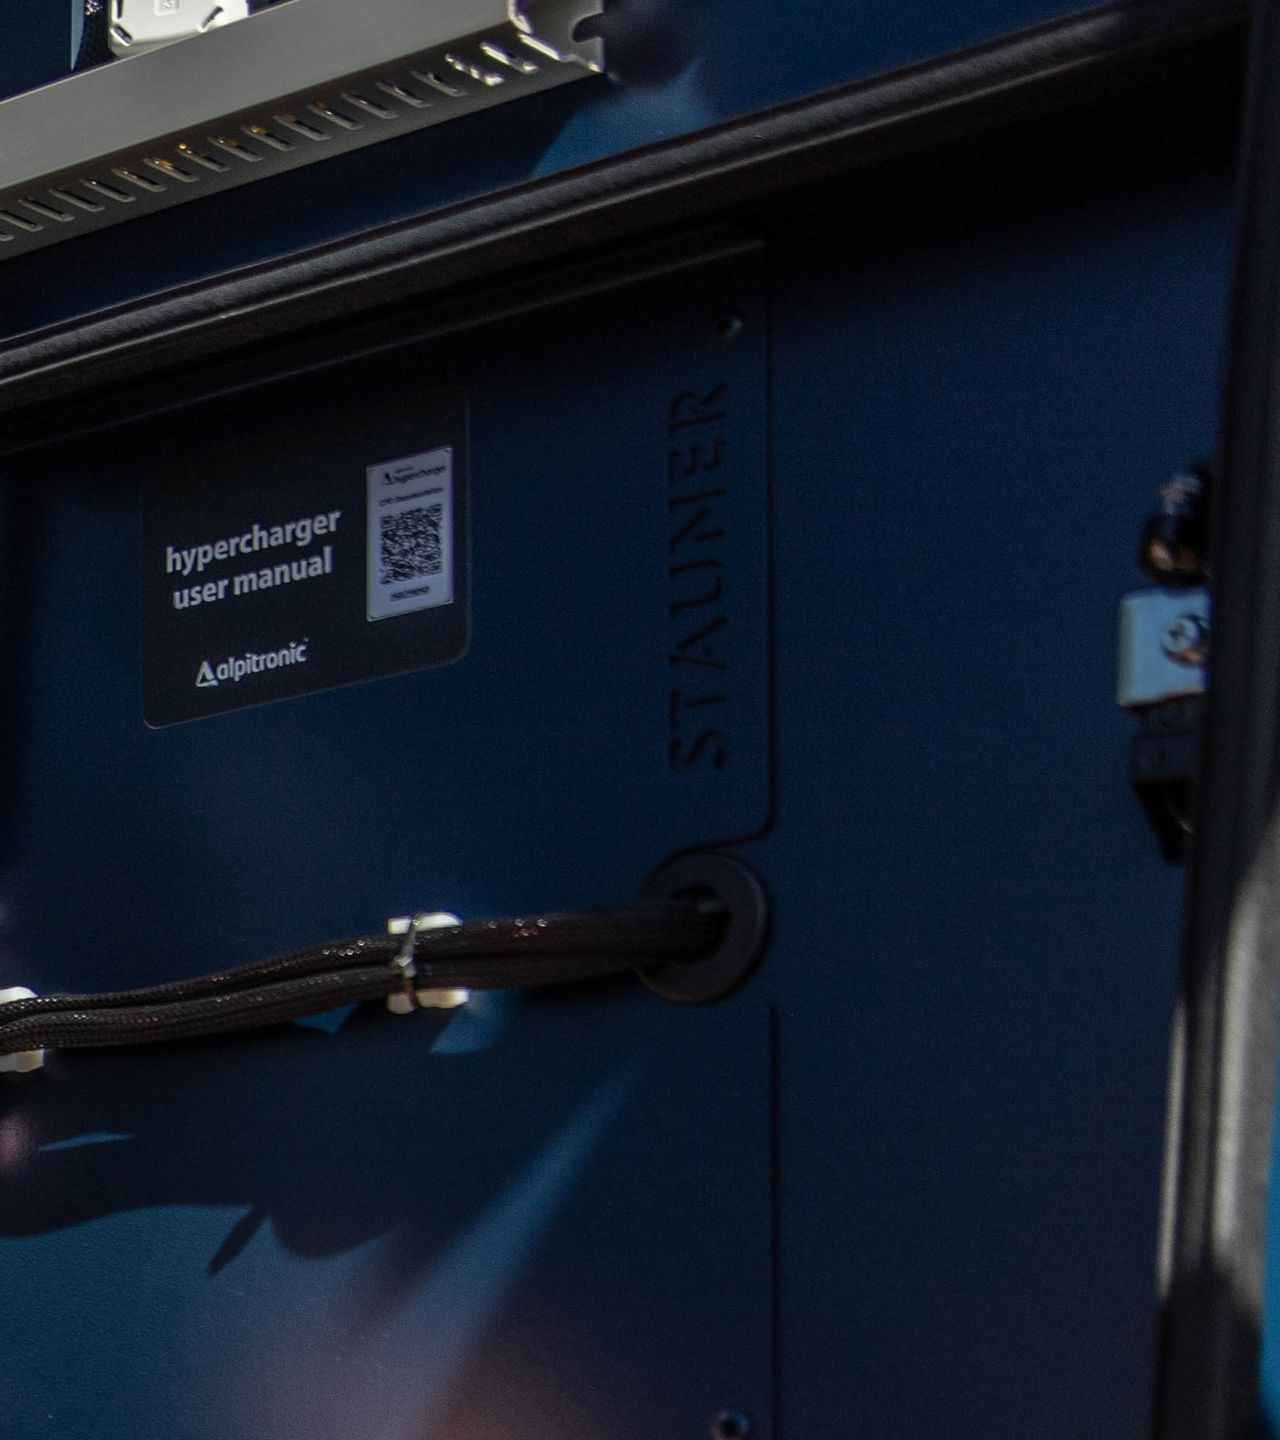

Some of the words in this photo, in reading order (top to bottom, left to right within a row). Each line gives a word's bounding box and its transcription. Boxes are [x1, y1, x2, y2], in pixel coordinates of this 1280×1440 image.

[166, 510, 342, 577] hypercharger
[668, 382, 728, 770] STAUNER
[173, 577, 230, 611] user
[233, 545, 333, 596] manual
[216, 641, 308, 681] alpitronic
